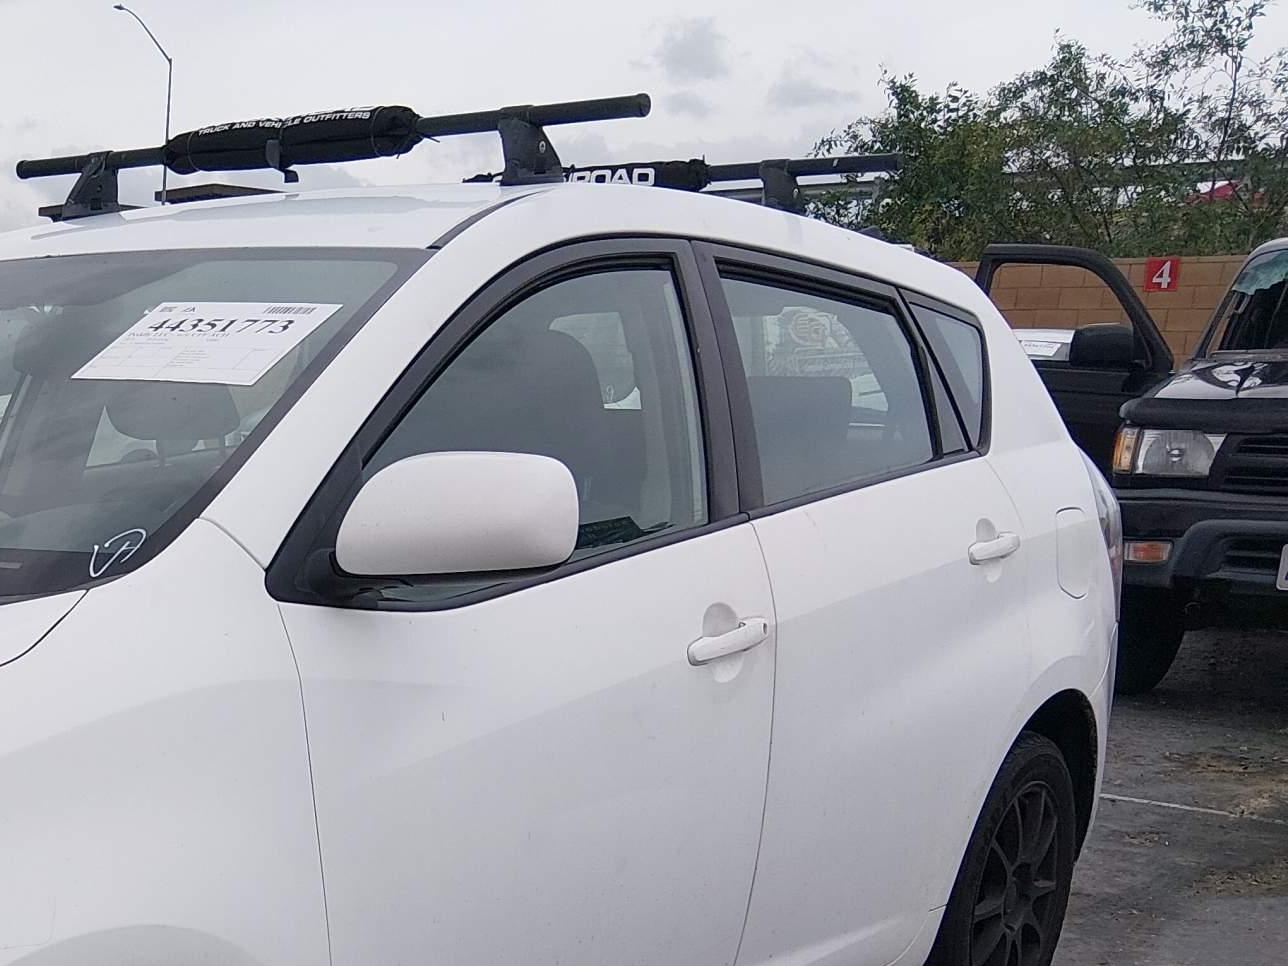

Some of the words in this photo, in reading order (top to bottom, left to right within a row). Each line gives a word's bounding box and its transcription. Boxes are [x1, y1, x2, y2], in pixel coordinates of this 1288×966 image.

[198, 124, 231, 136] TRUCK
[232, 121, 256, 130] AND
[303, 111, 371, 123] OUTFITTERS
[1152, 260, 1171, 289] 4
[148, 318, 295, 334] 44351773
